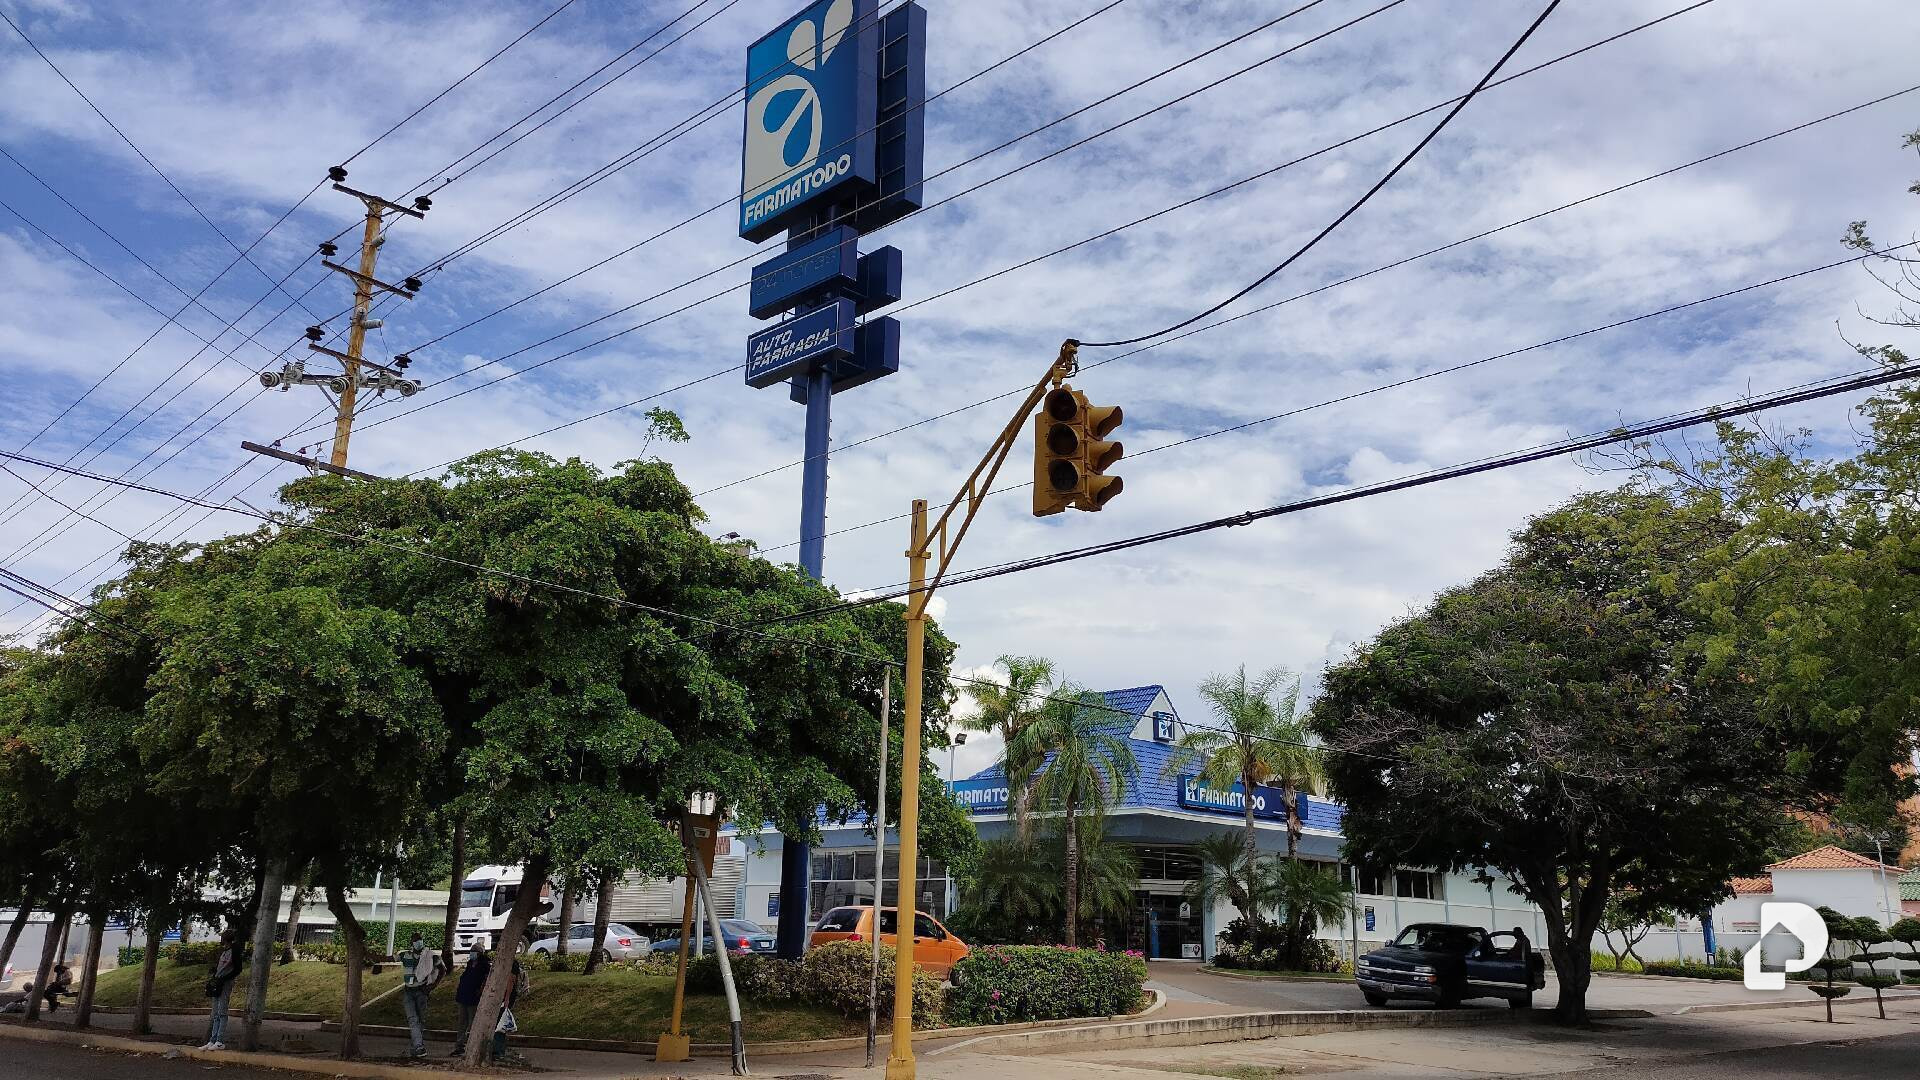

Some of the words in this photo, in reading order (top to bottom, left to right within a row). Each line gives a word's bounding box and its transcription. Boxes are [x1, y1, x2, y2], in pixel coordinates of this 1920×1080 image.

[744, 154, 851, 226] FARMATODO
[751, 328, 830, 370] FARMACIA
[753, 330, 793, 357] AUTO
